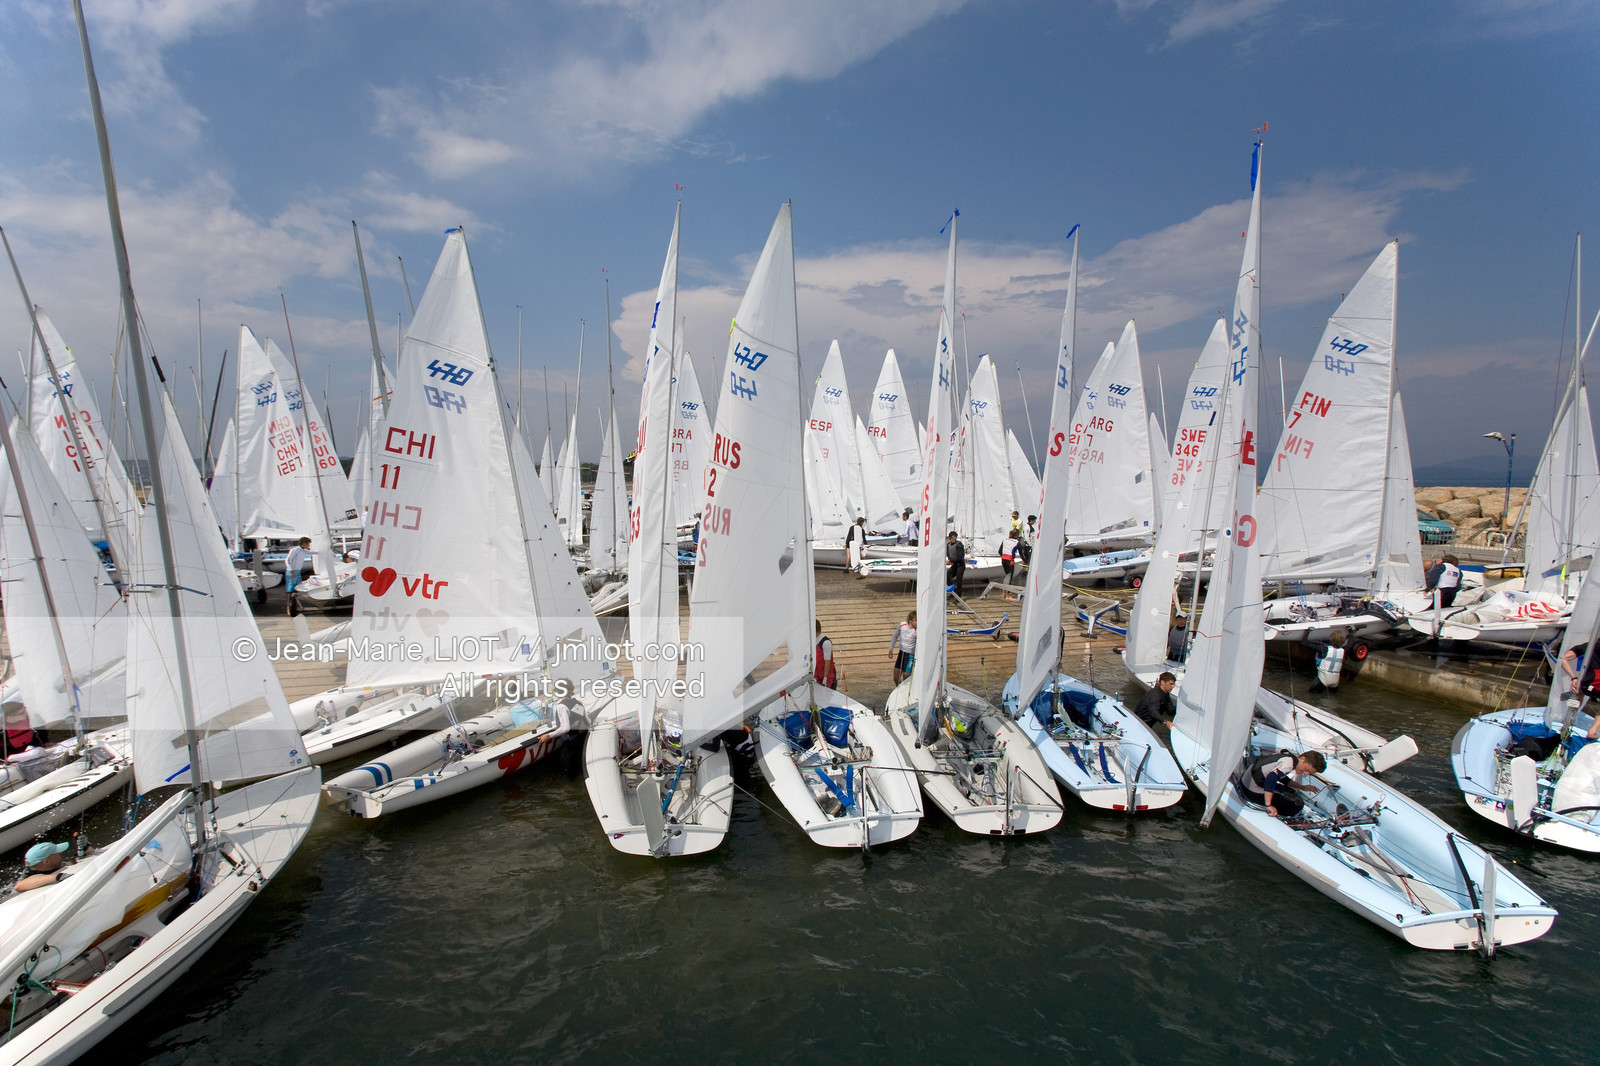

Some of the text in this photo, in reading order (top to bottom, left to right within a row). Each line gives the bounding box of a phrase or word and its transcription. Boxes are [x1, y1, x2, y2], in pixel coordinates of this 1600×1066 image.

[1329, 336, 1369, 356] 470
[733, 342, 768, 371] 470
[426, 359, 474, 387] 470
[825, 386, 843, 397] 470
[879, 393, 898, 402] 470
[1109, 383, 1131, 396] 470
[1193, 386, 1218, 397] 470
[257, 392, 277, 407] 470
[681, 401, 699, 411] 470
[1300, 391, 1332, 418] FIN
[810, 419, 833, 433] ESP
[1089, 415, 1114, 433] ARG
[1287, 411, 1302, 429] 7
[867, 426, 887, 438] FRA
[1180, 428, 1207, 443] SWE
[276, 442, 299, 461] CHN
[385, 426, 436, 460] CHI
[713, 432, 742, 470] RUS
[1175, 443, 1200, 458] 346
[277, 455, 303, 477] 1267
[380, 463, 401, 490] 11
[707, 467, 717, 498] 2
[401, 573, 449, 600] vtr
